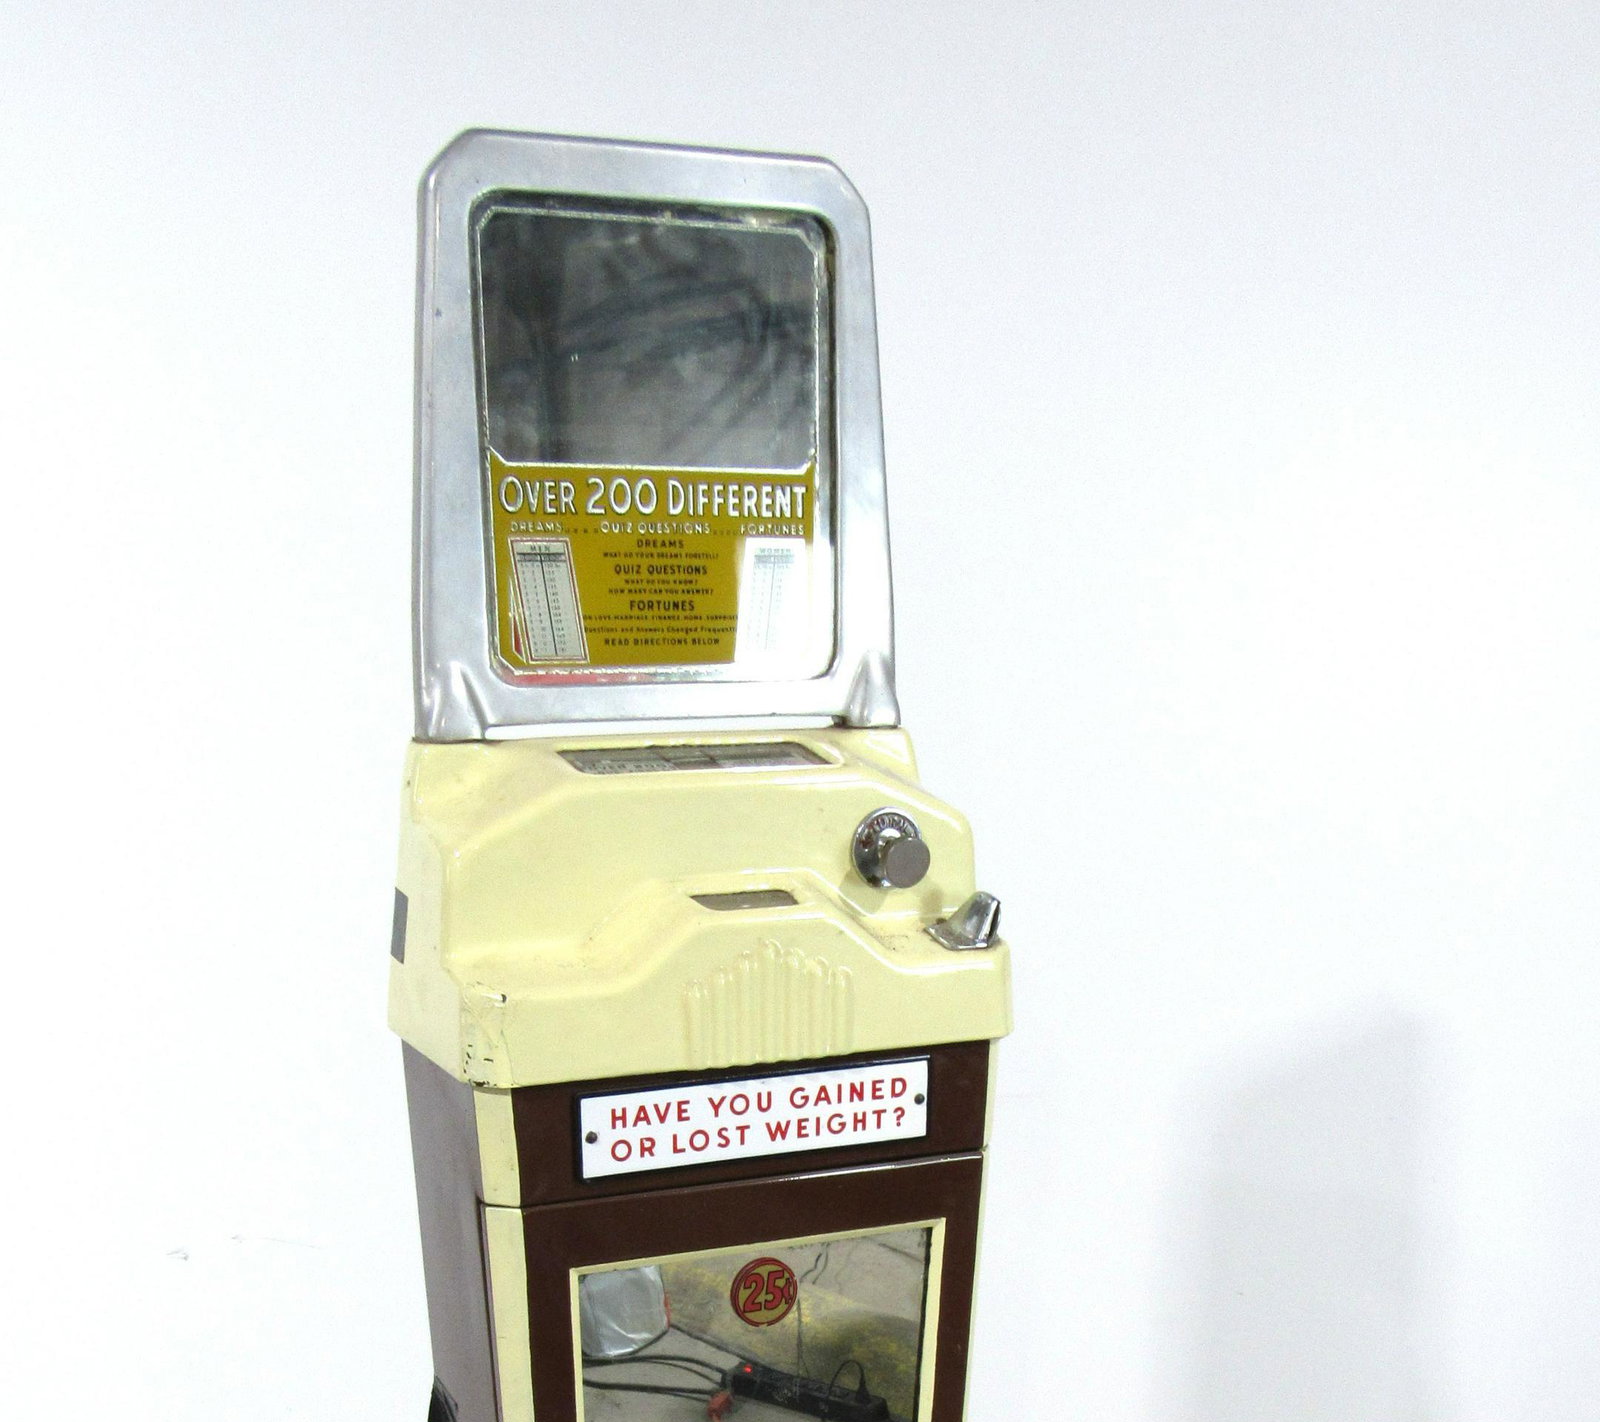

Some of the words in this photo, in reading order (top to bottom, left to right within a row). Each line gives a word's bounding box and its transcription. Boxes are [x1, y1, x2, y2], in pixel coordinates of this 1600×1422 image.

[500, 476, 577, 515] OVER
[586, 477, 659, 515] 200
[667, 479, 808, 519] DIFFERENT
[511, 521, 563, 532] DREAMS
[600, 521, 632, 533] QUIZ
[638, 522, 710, 534] QUESTIONS
[740, 523, 804, 535] FORTUNES
[637, 539, 684, 549] DREAMS
[614, 564, 642, 575] QUIZ
[648, 564, 708, 575] QUESTIONS
[629, 600, 695, 611] FORTUNES
[604, 638, 630, 646] READ
[634, 638, 688, 646] DIRECTIONS
[611, 1100, 691, 1130] HAVE
[708, 1091, 773, 1118] YOU
[789, 1077, 907, 1109] GAINED
[611, 1137, 656, 1162] OR
[672, 1125, 750, 1154] LOST
[765, 1106, 906, 1142] WEIGHT?
[742, 1269, 796, 1314] 25¢
